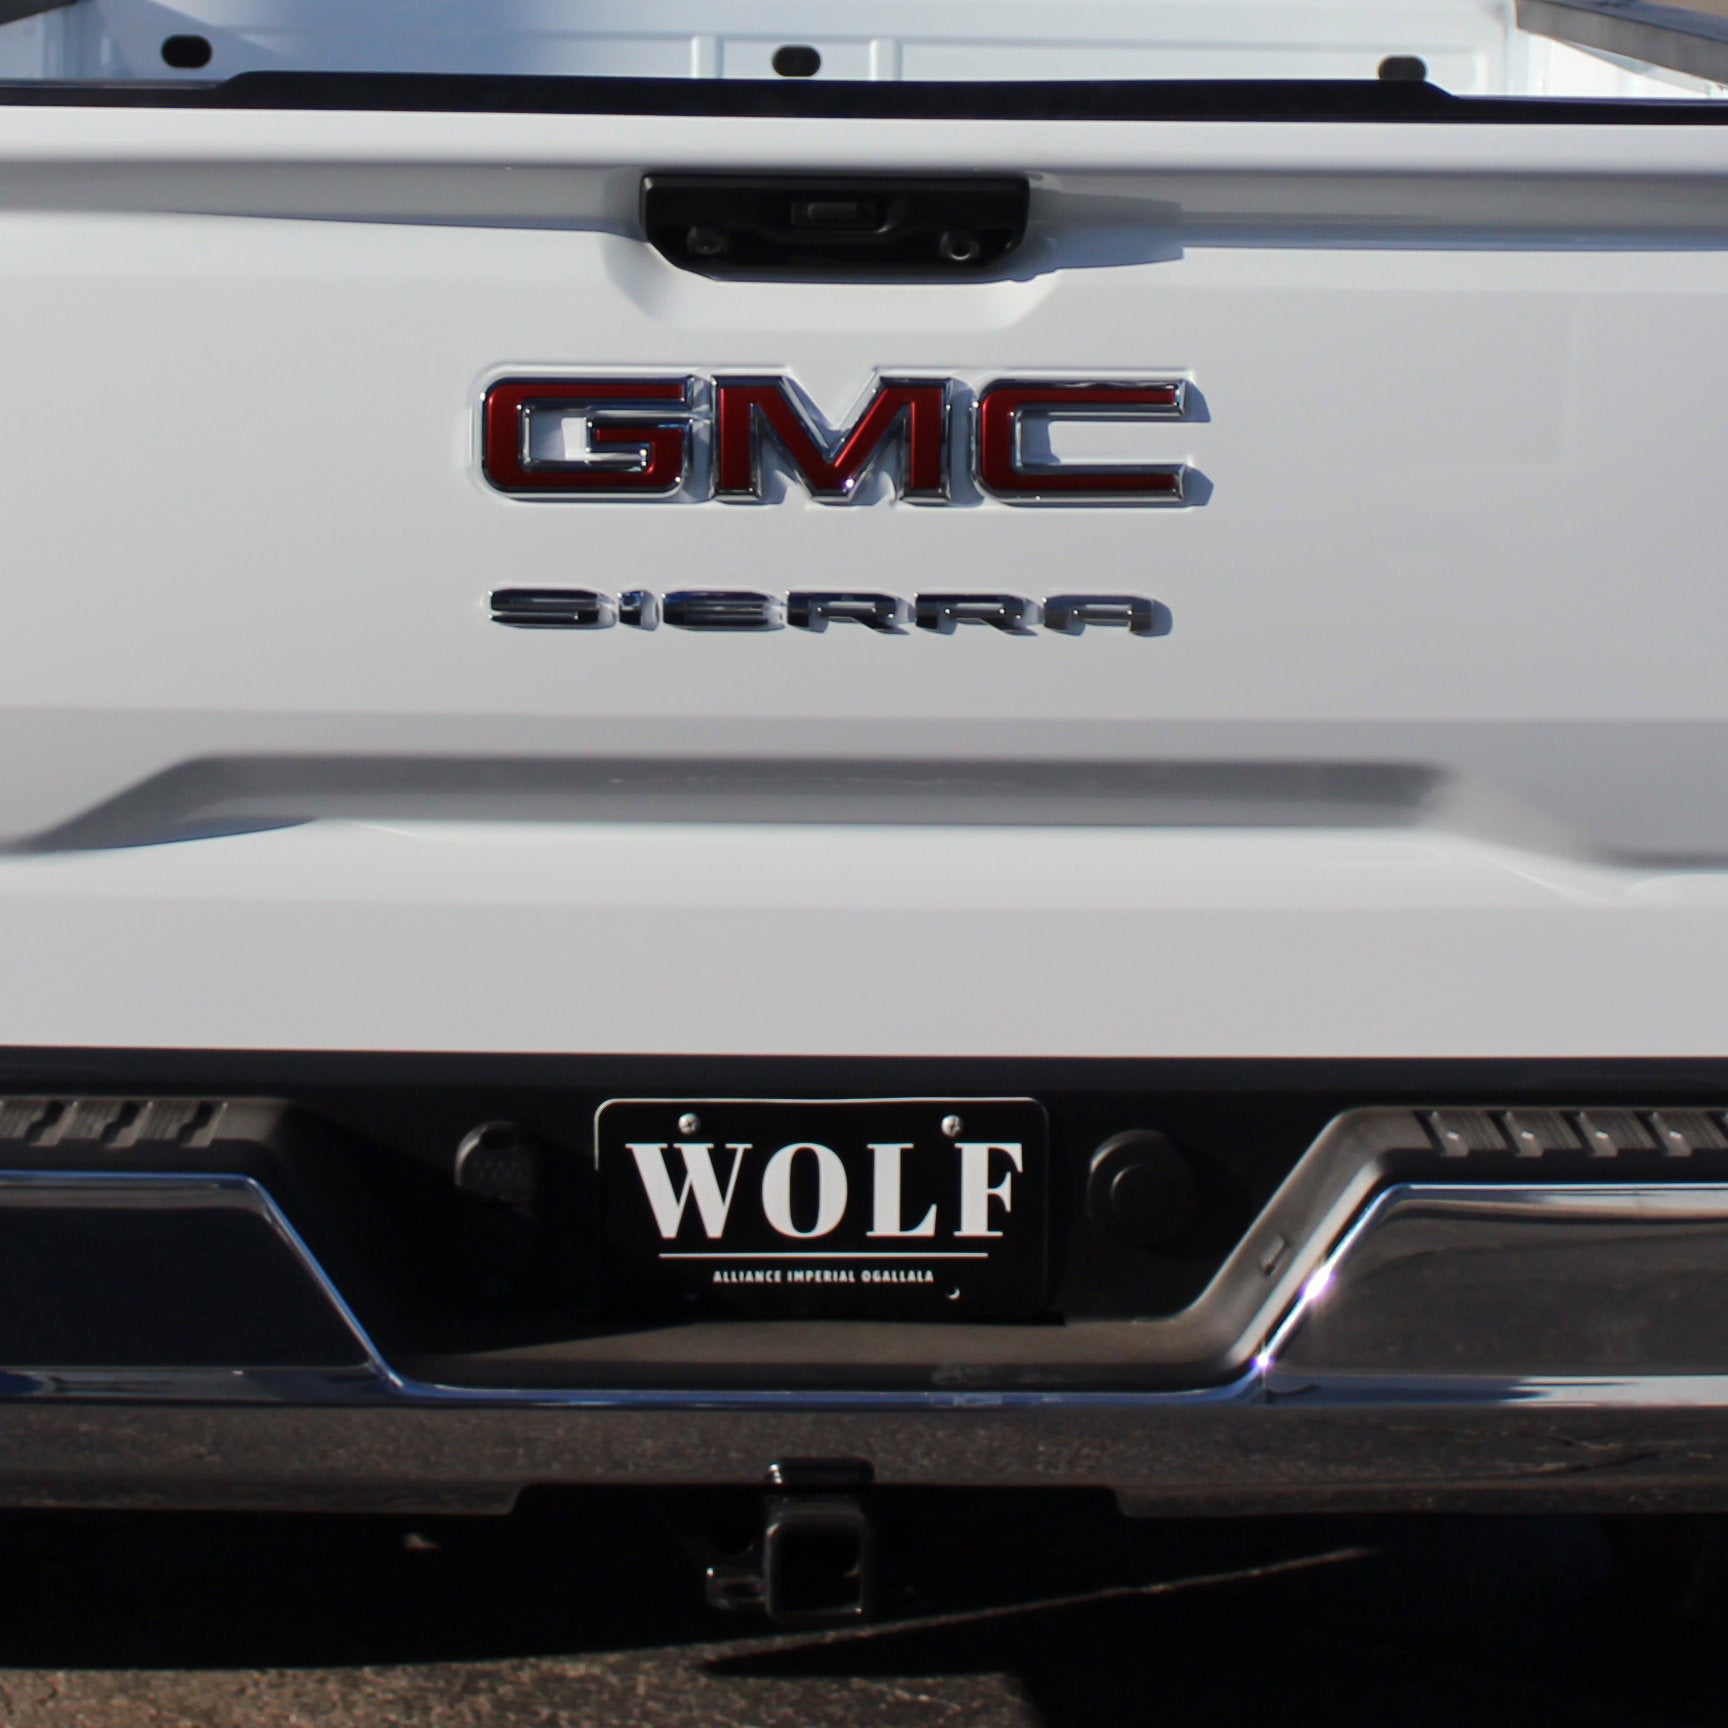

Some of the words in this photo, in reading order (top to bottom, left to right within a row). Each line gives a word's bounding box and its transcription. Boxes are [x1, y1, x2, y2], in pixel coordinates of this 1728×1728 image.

[479, 372, 1186, 506] GMC
[488, 588, 1156, 635] SIERRA
[625, 1141, 1024, 1239] WOLF
[712, 1270, 783, 1283] ALLIANCE
[786, 1270, 856, 1283] IMPERIAL
[860, 1270, 935, 1283] OGALLALA
